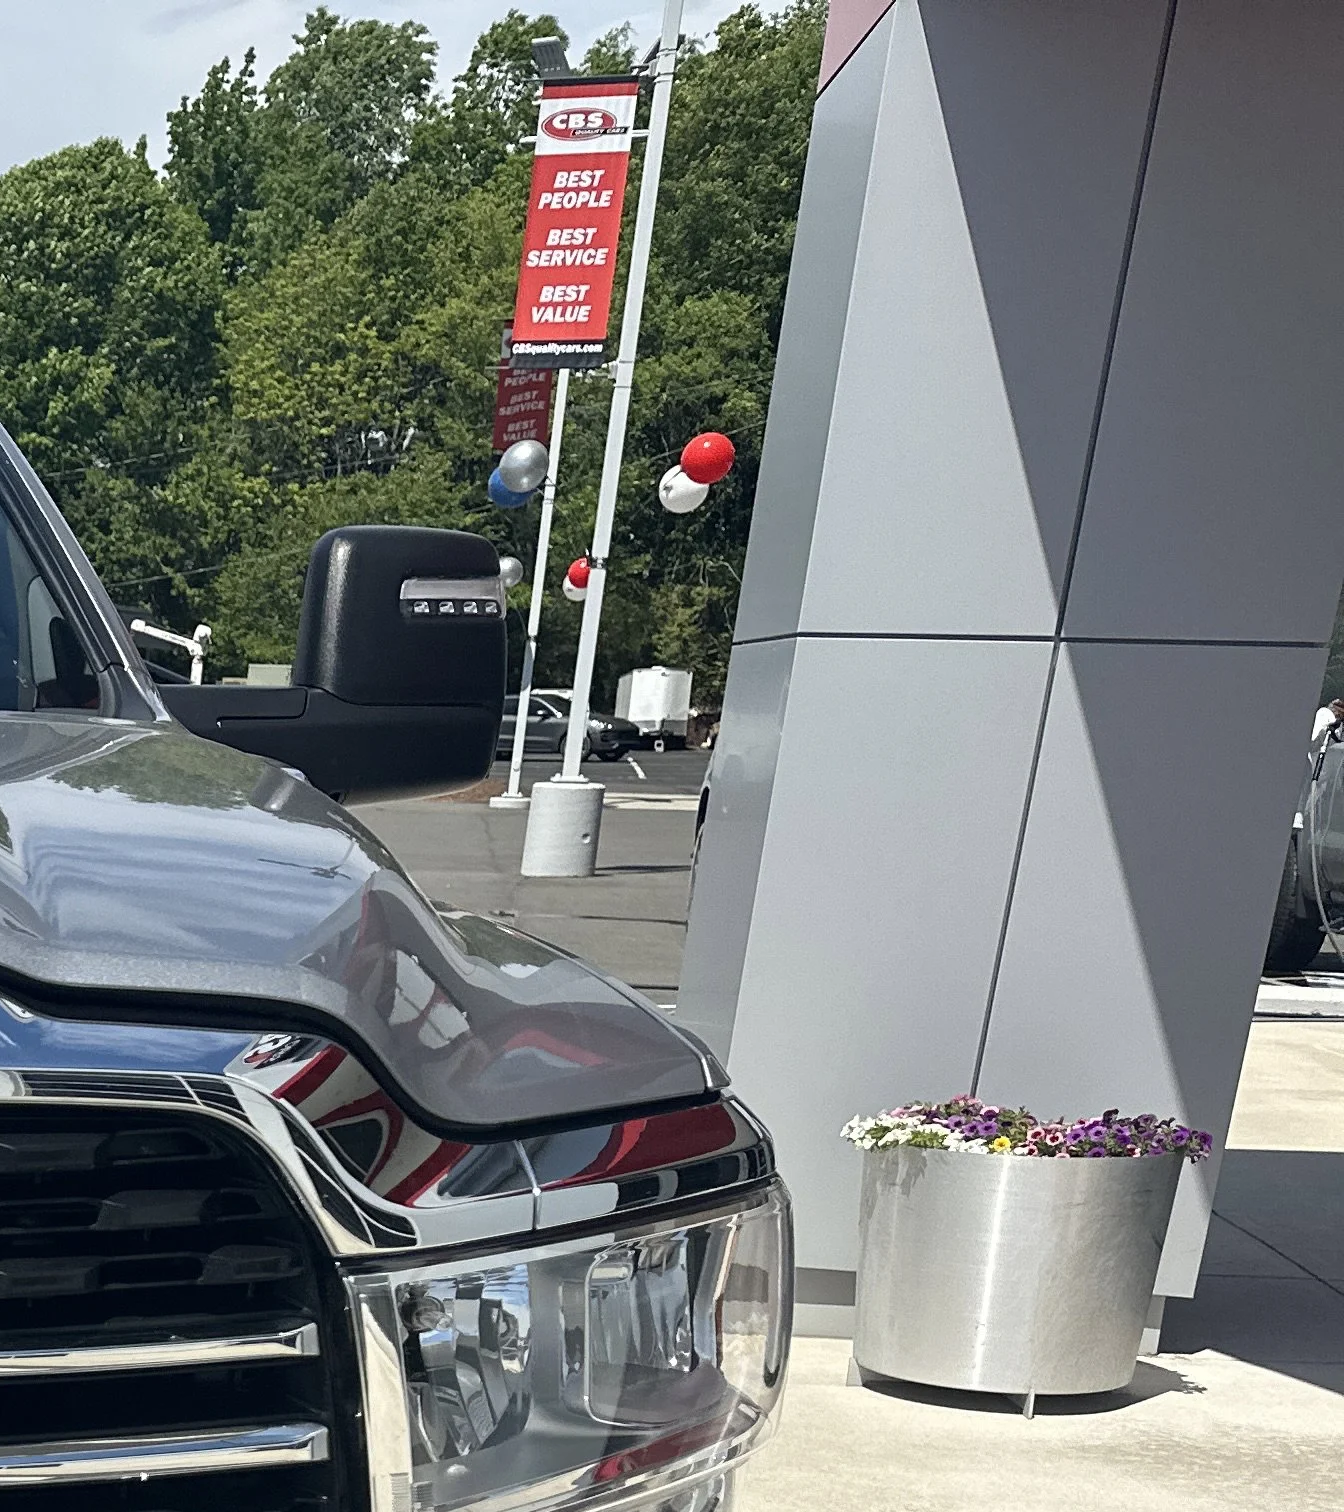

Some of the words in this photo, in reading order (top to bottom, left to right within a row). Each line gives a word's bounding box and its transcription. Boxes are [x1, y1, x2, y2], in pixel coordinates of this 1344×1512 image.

[552, 112, 603, 129] CBS
[553, 169, 605, 188] BEST
[537, 190, 613, 209] PEOPLE
[546, 227, 597, 245] BEST
[525, 247, 608, 266] SERVICE
[539, 284, 590, 302] BEST
[531, 305, 591, 323] VALUE
[512, 342, 603, 355] CBSqualitycars.com
[510, 390, 538, 403] BEST
[498, 400, 544, 415] SERVICE
